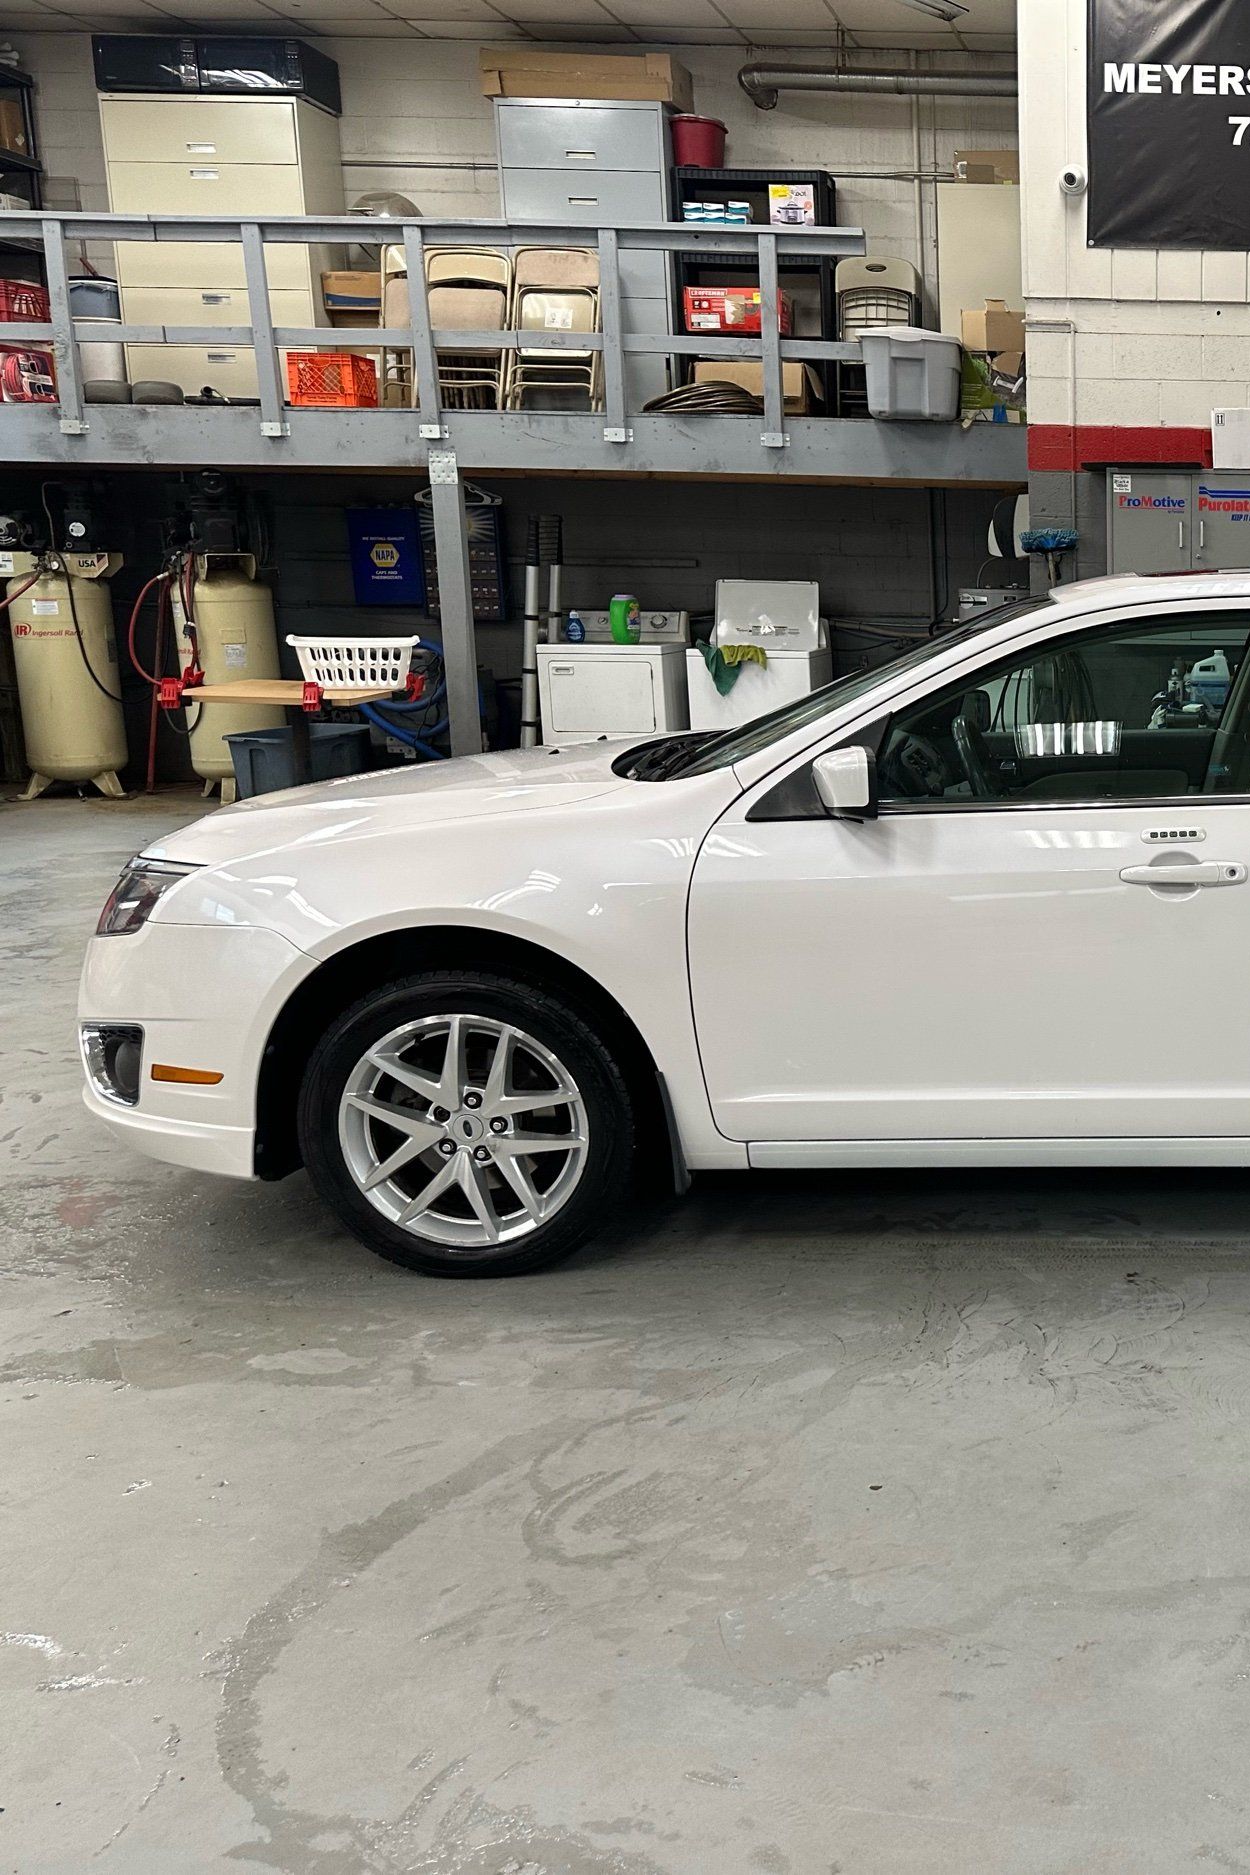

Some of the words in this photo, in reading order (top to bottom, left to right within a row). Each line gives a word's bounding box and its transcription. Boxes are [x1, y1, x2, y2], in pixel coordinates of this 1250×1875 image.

[1119, 496, 1185, 507] ProMotive
[375, 550, 395, 561] NAPA
[79, 560, 96, 568] USA
[32, 629, 63, 638] Ingersoll
